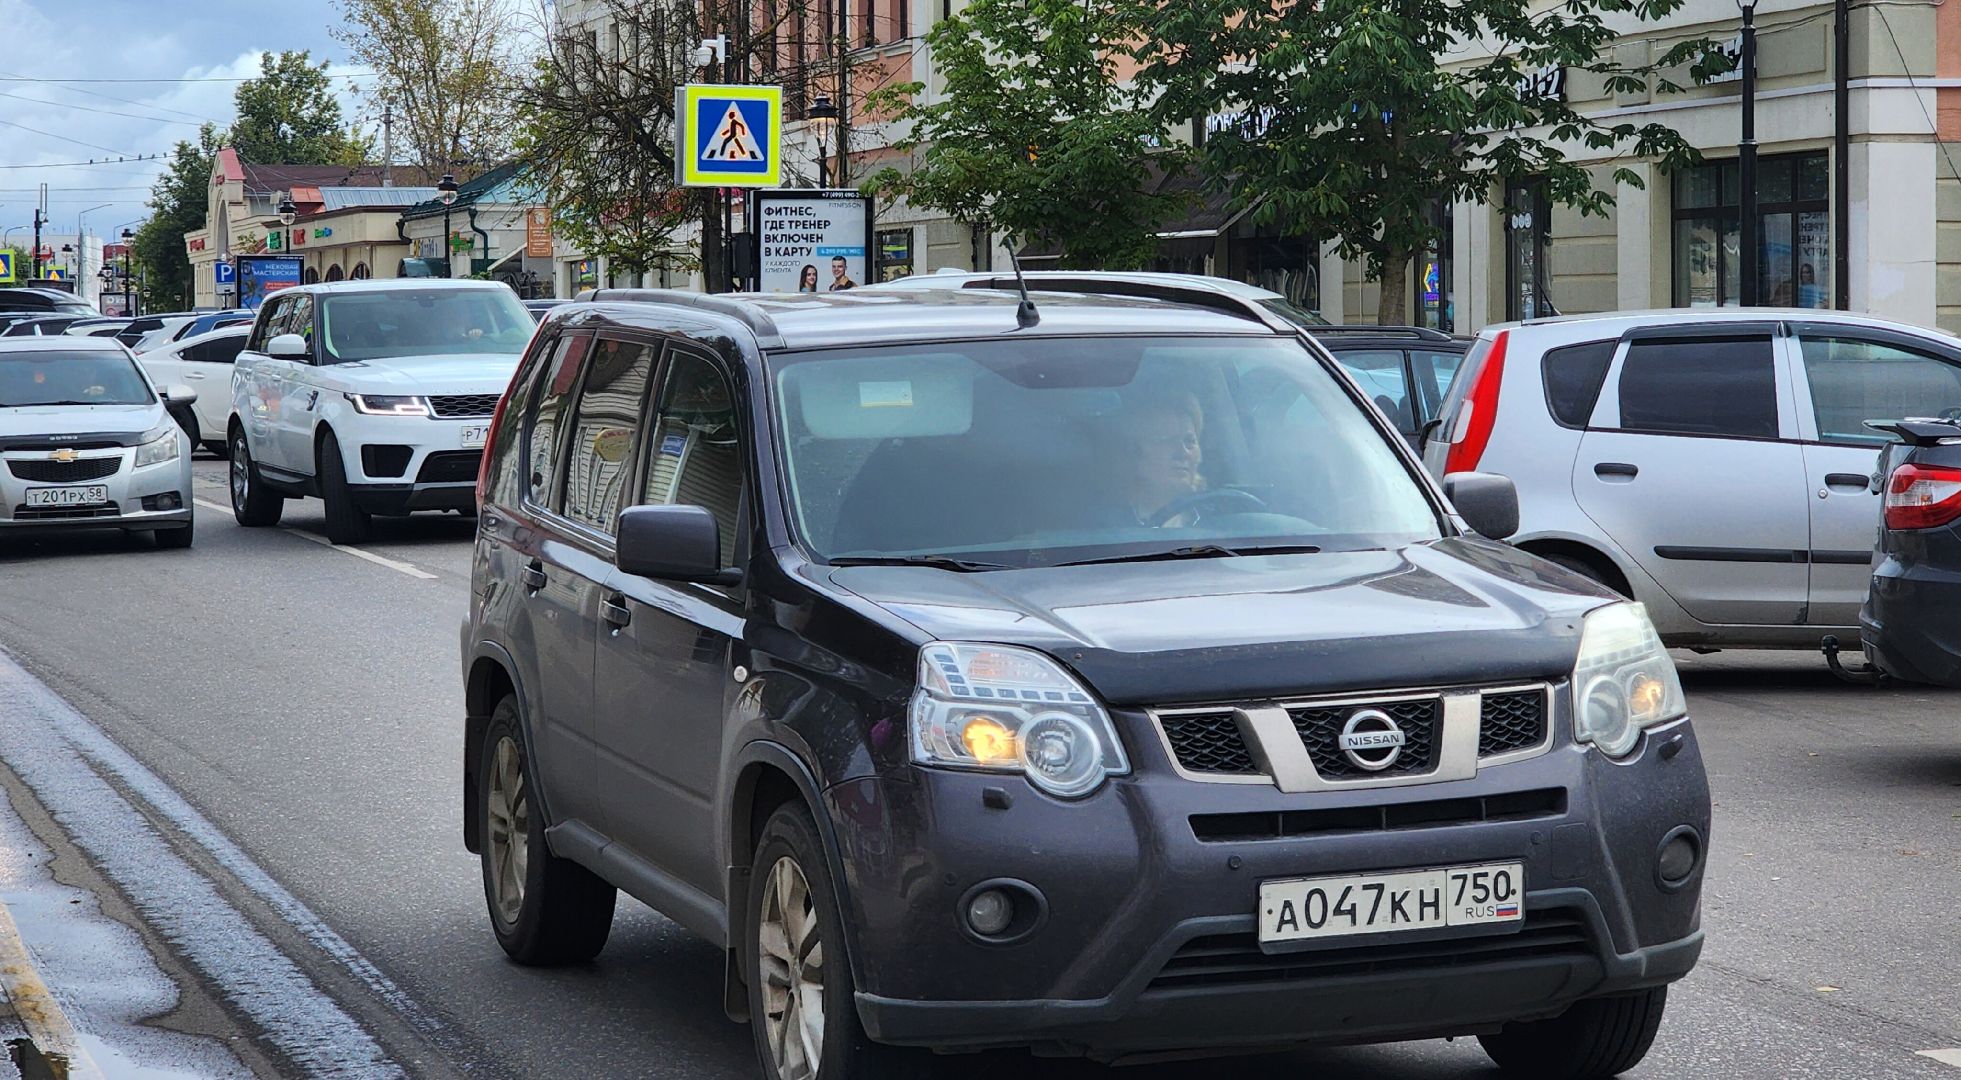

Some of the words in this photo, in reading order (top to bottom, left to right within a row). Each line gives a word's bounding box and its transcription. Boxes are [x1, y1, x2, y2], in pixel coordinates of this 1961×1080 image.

[764, 206, 816, 217] ФИТНЕС,
[764, 220, 785, 231] ГДЕ
[787, 220, 831, 230] ТРЕНЕР
[764, 233, 824, 243] ВКЛЮЧЕН
[764, 247, 772, 257] В
[775, 247, 813, 257] КАРТУ
[88, 487, 102, 498] 58
[1348, 734, 1400, 746] NISSAN
[1451, 870, 1511, 906] 750
[1465, 905, 1495, 919] RUS
